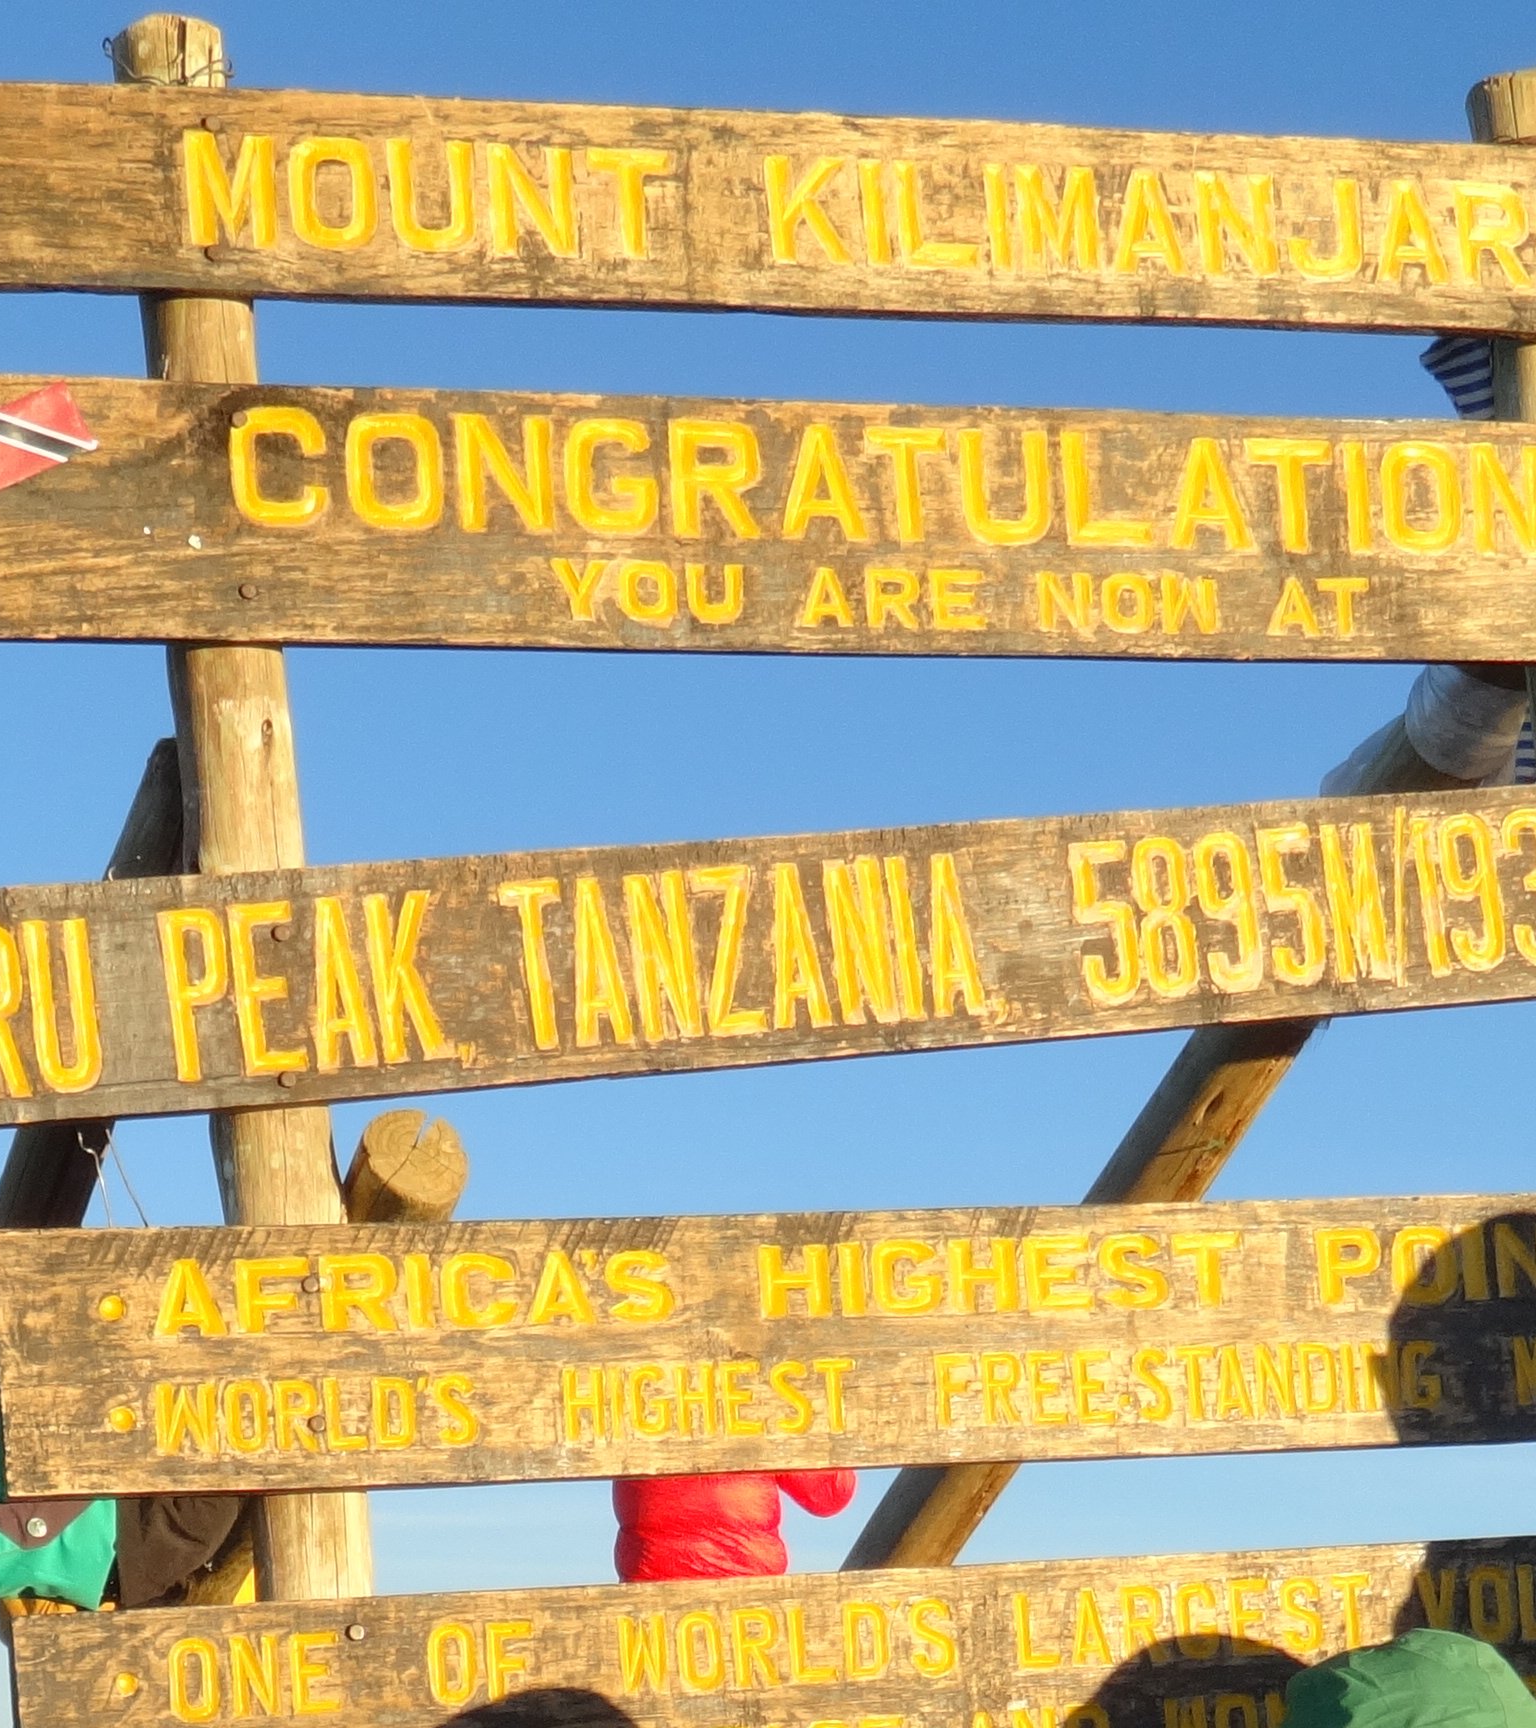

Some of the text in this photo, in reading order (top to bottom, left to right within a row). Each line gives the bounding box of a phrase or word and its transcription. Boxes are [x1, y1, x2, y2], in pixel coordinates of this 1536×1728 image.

[182, 129, 671, 259] MOUNT
[550, 557, 1370, 638] YOU ARE NOW AT
[154, 1249, 675, 1337] AFRICA'S
[758, 1230, 1239, 1320] HIGHEST
[154, 1375, 479, 1455] WORLD'S
[563, 1357, 855, 1445] HIGHEST
[168, 1630, 339, 1723] ONE
[427, 1620, 534, 1706] OF
[1014, 1572, 1371, 1670] LARGEST
